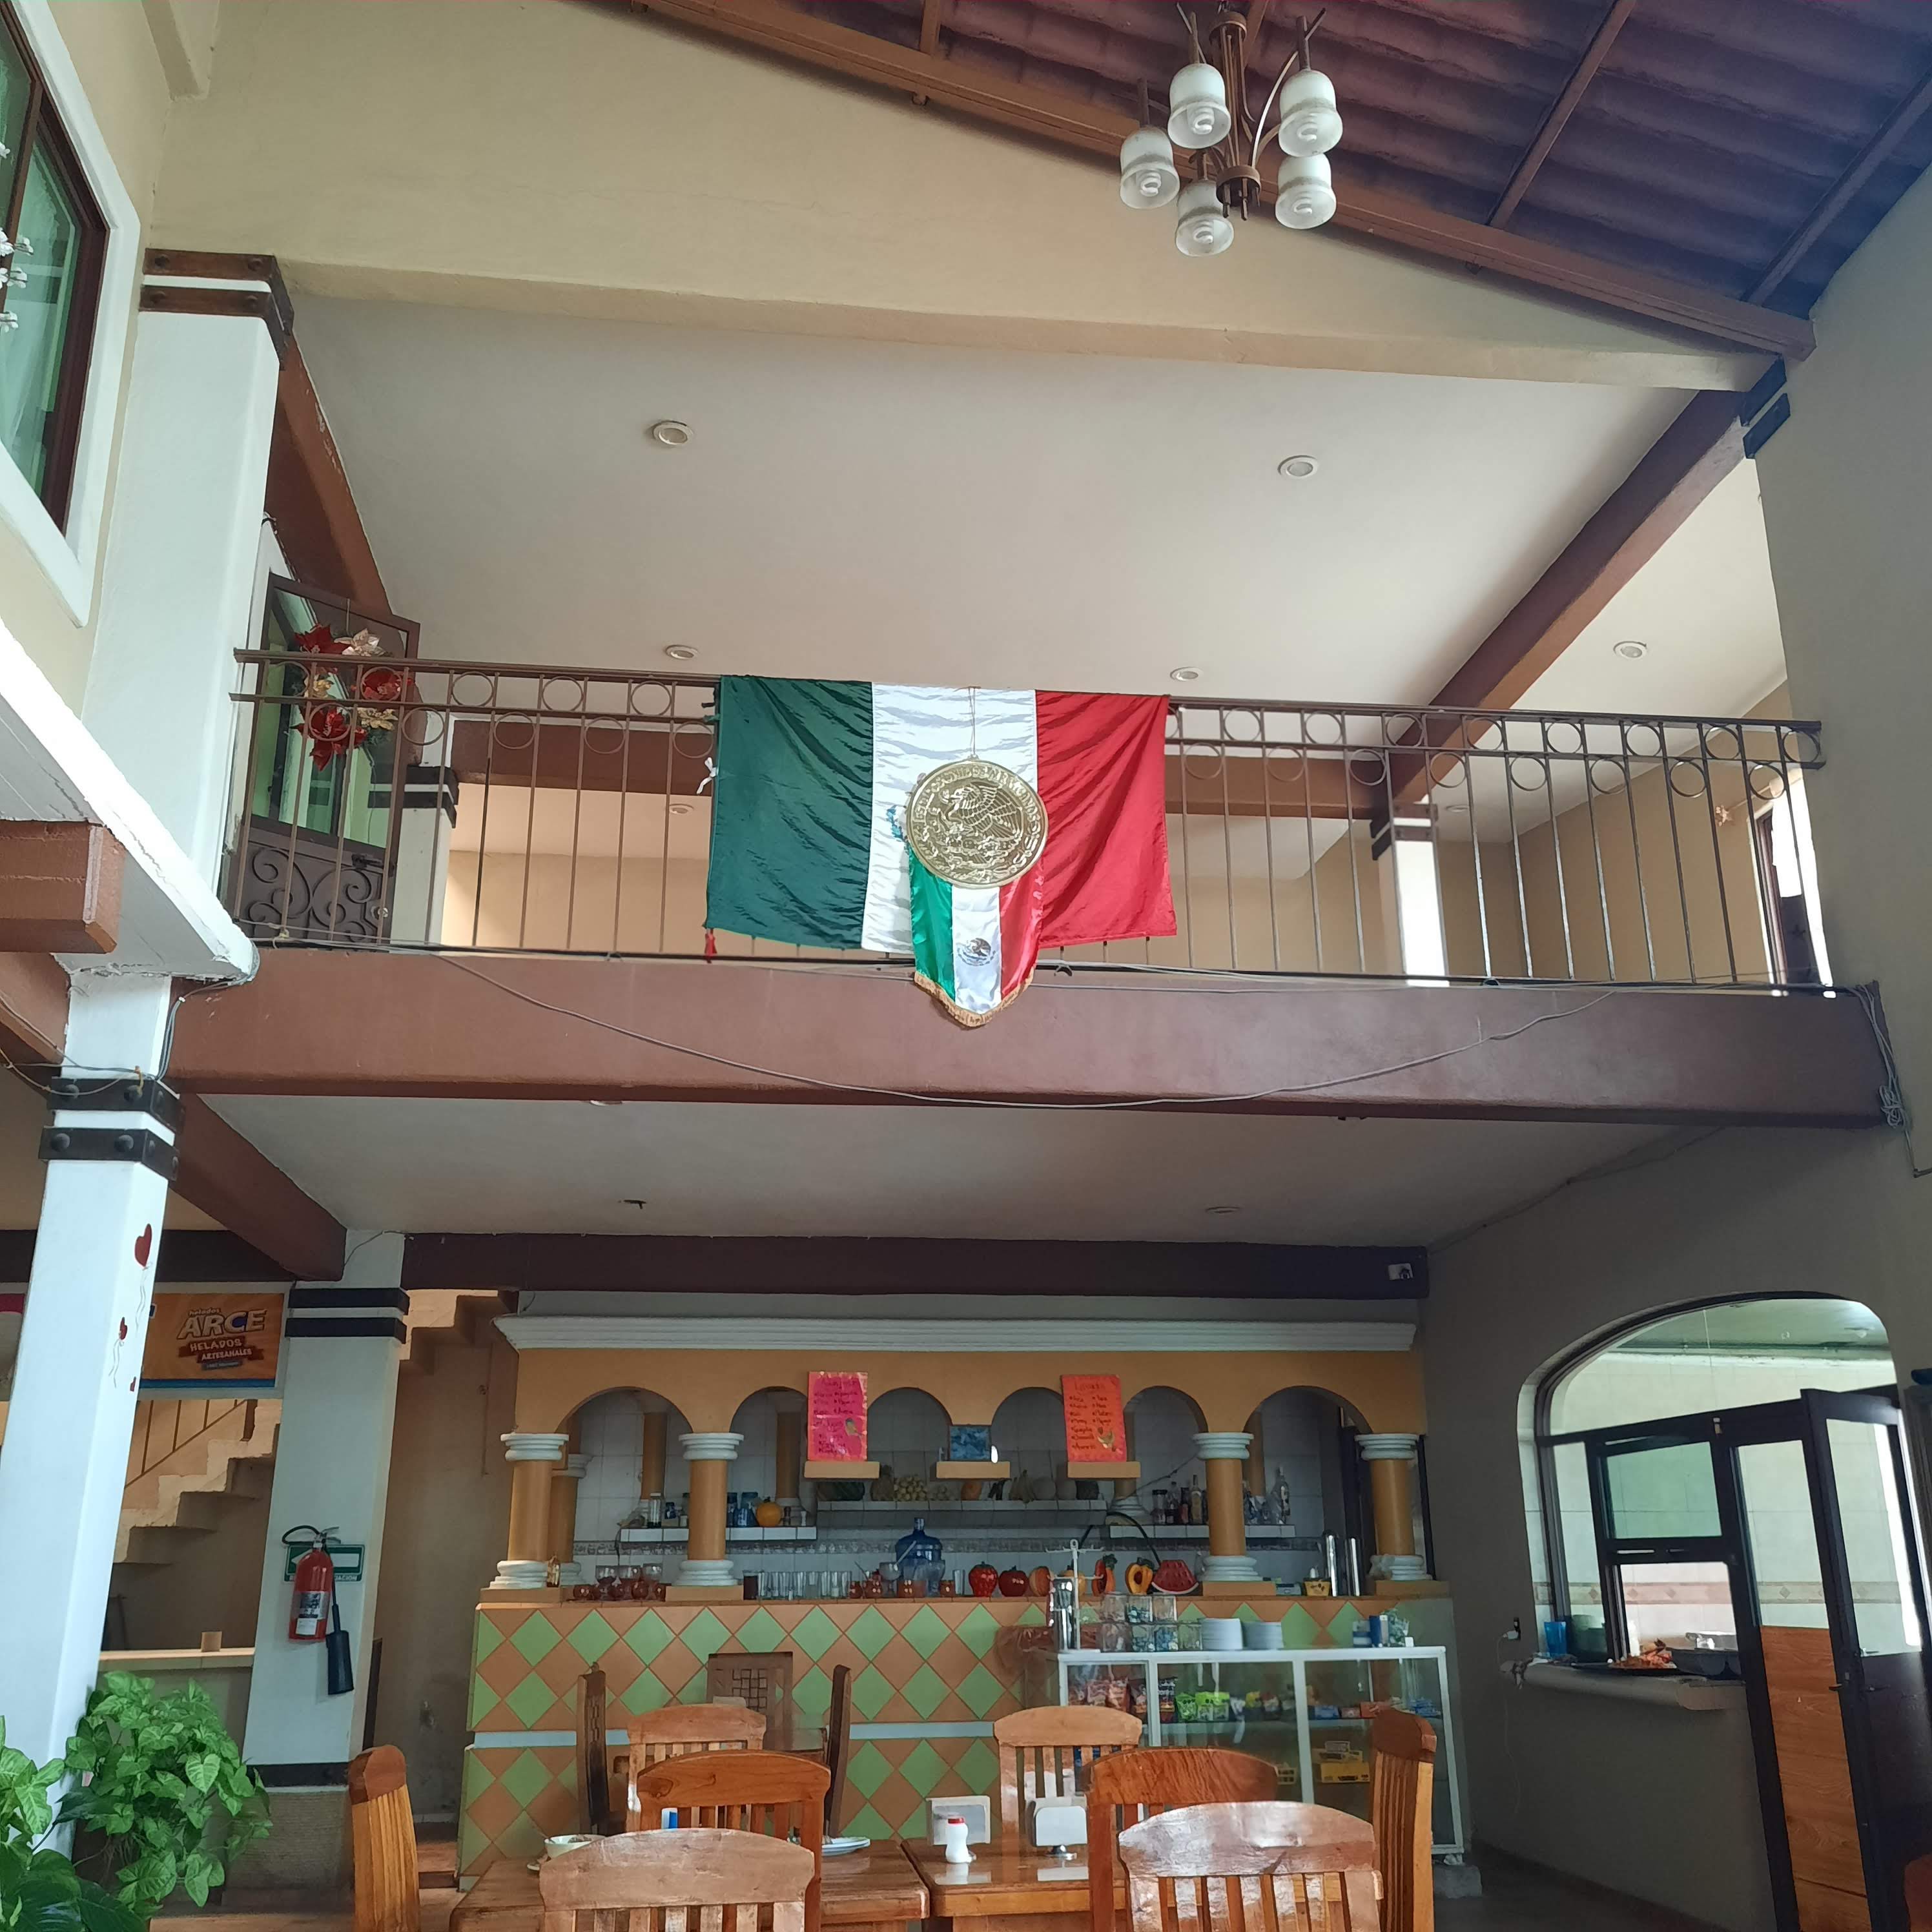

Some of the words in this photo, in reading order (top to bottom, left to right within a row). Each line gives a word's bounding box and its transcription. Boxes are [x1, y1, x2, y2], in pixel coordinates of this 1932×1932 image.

[177, 1310, 267, 1339] ARCE
[190, 1339, 242, 1351] HELADOS
[201, 1348, 252, 1361] ARTESANALES
